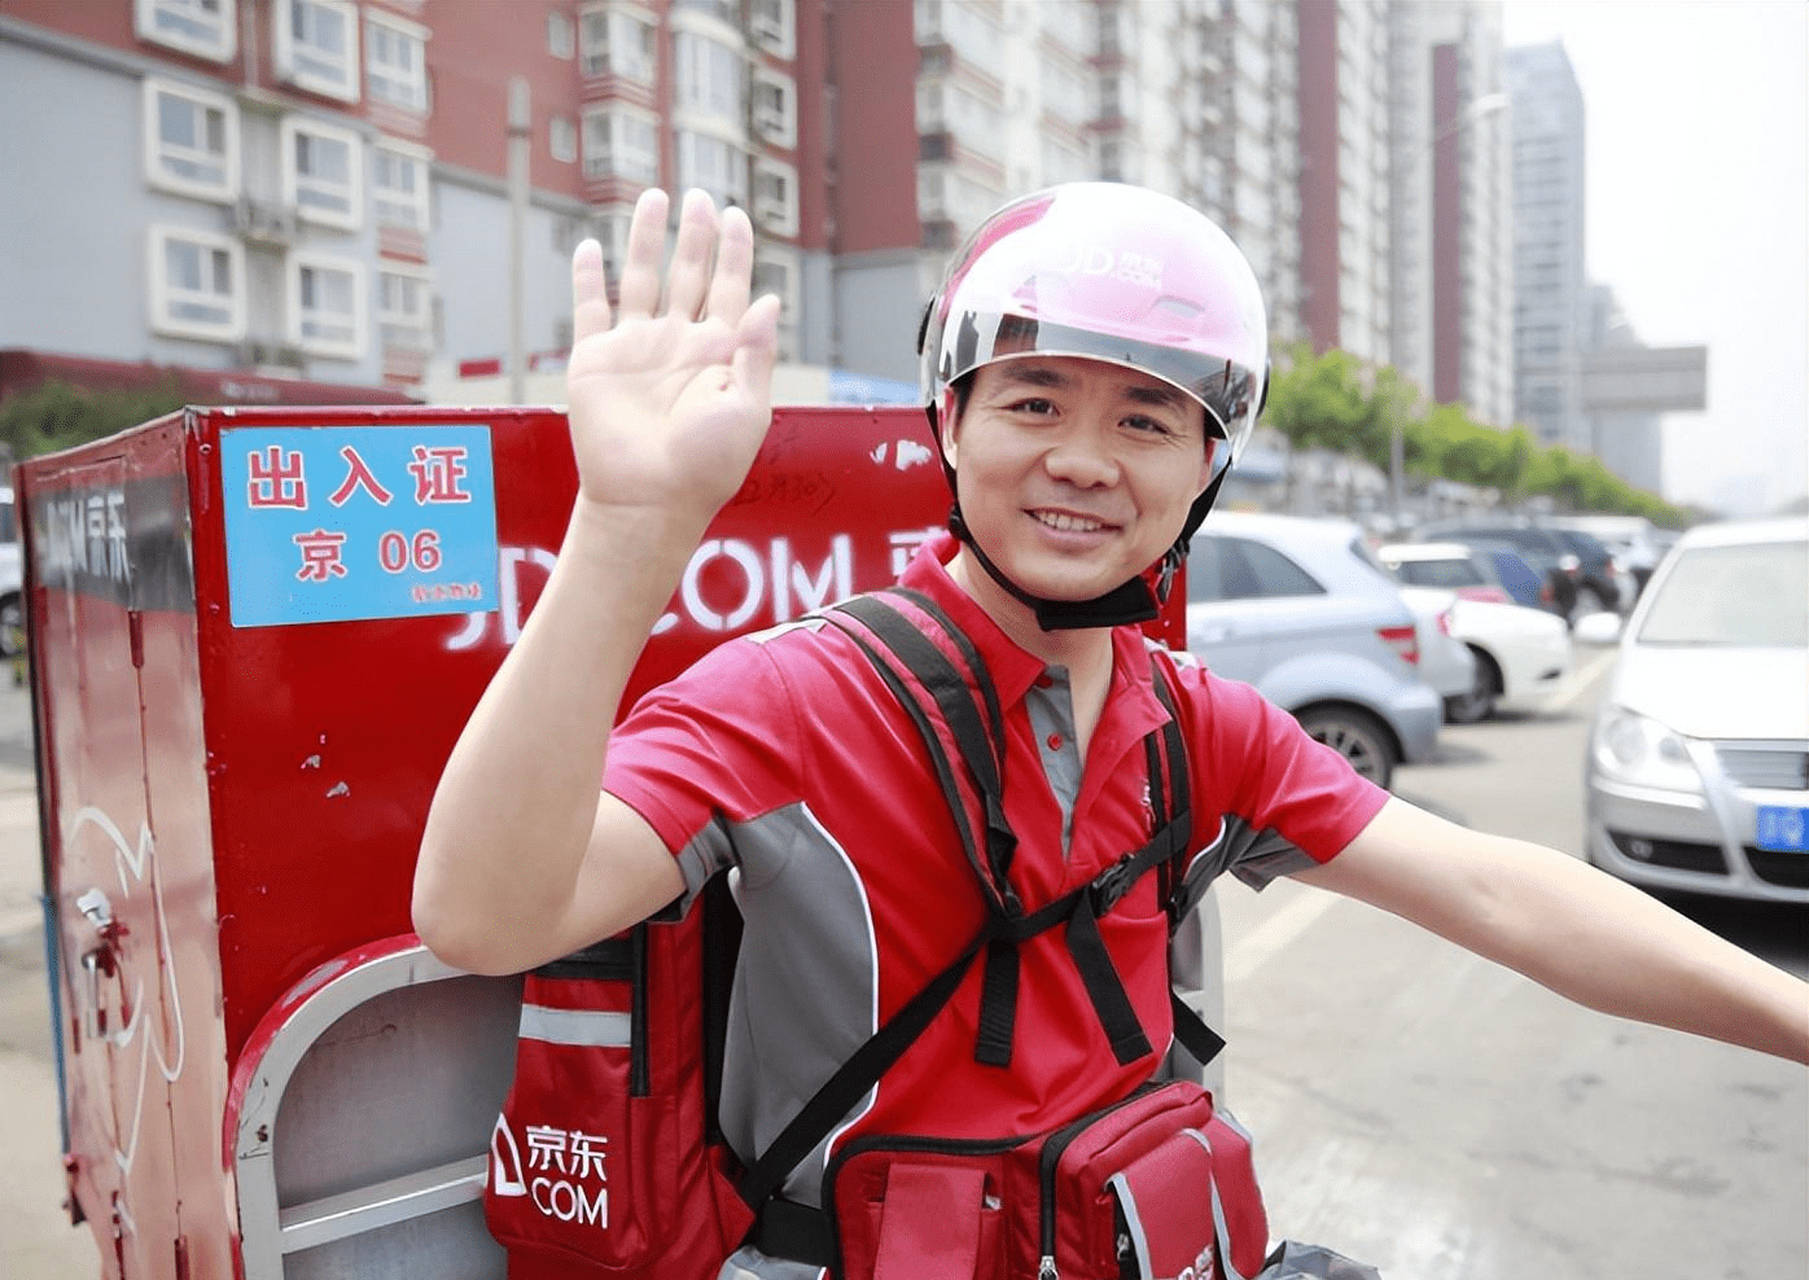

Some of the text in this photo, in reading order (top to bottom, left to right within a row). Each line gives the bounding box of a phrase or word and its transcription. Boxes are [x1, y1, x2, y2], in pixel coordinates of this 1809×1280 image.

[248, 446, 472, 510] 出入证
[293, 528, 442, 582] 京 06
[526, 1125, 608, 1182] 京东
[532, 1177, 608, 1229] COM
